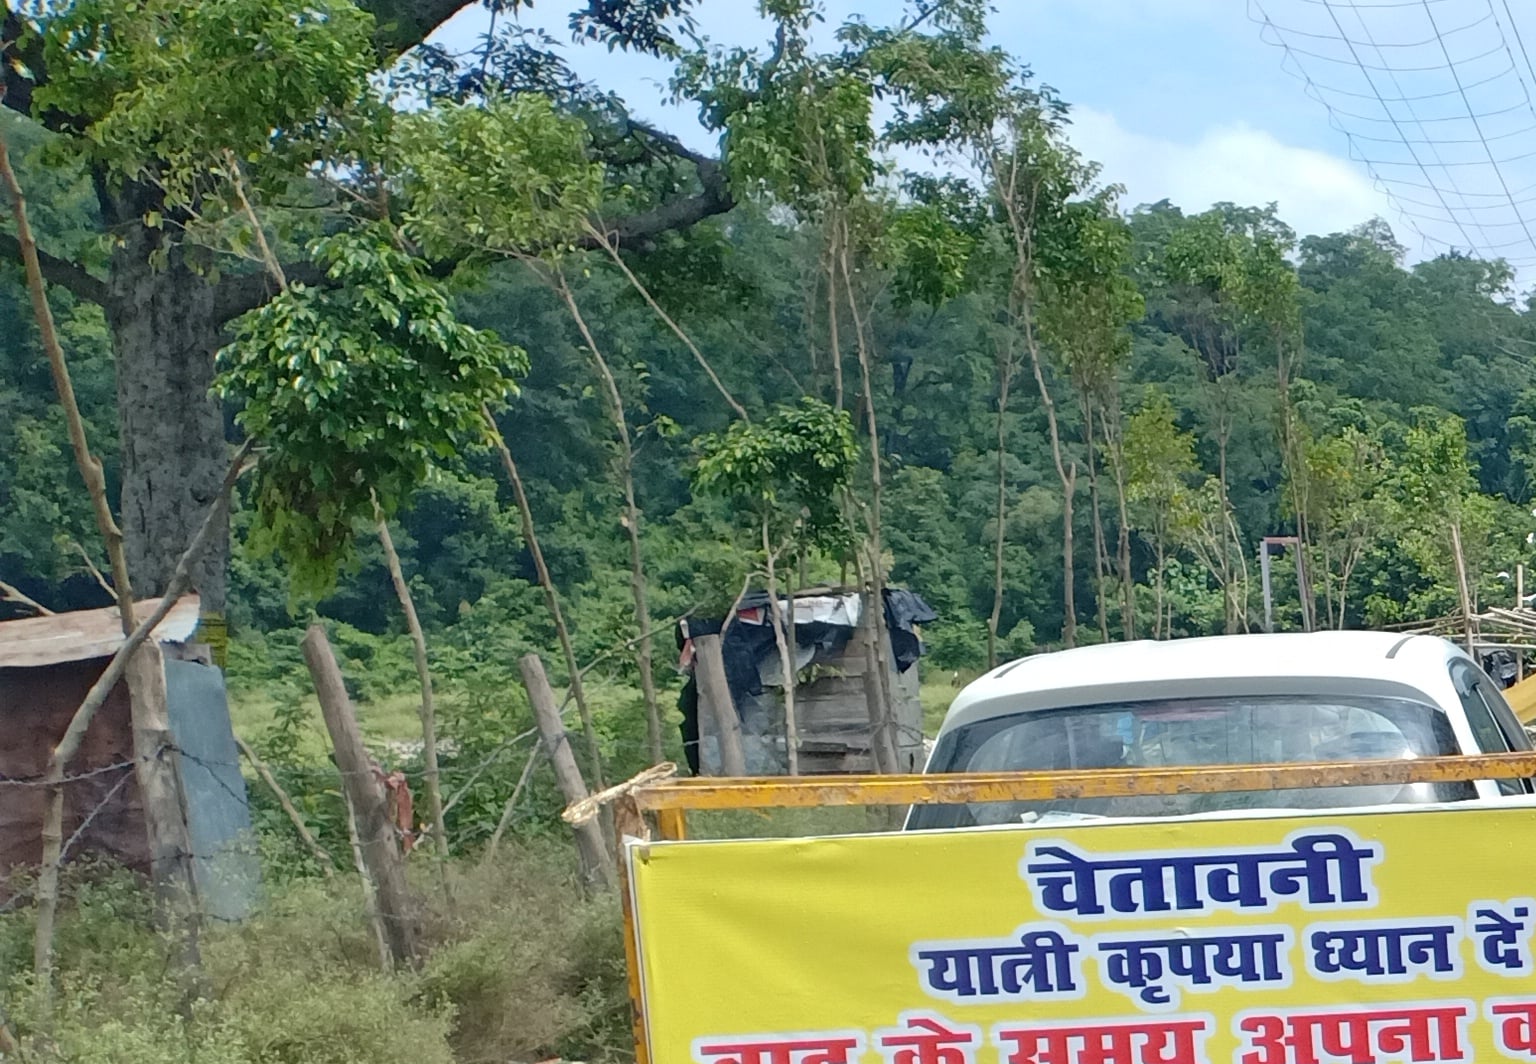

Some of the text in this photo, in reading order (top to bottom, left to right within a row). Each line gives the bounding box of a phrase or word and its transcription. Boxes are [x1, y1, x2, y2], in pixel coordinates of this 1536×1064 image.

[1028, 834, 1374, 915] चेतावनी
[918, 906, 1529, 1004] यात्री कृपया ध्यान दें
